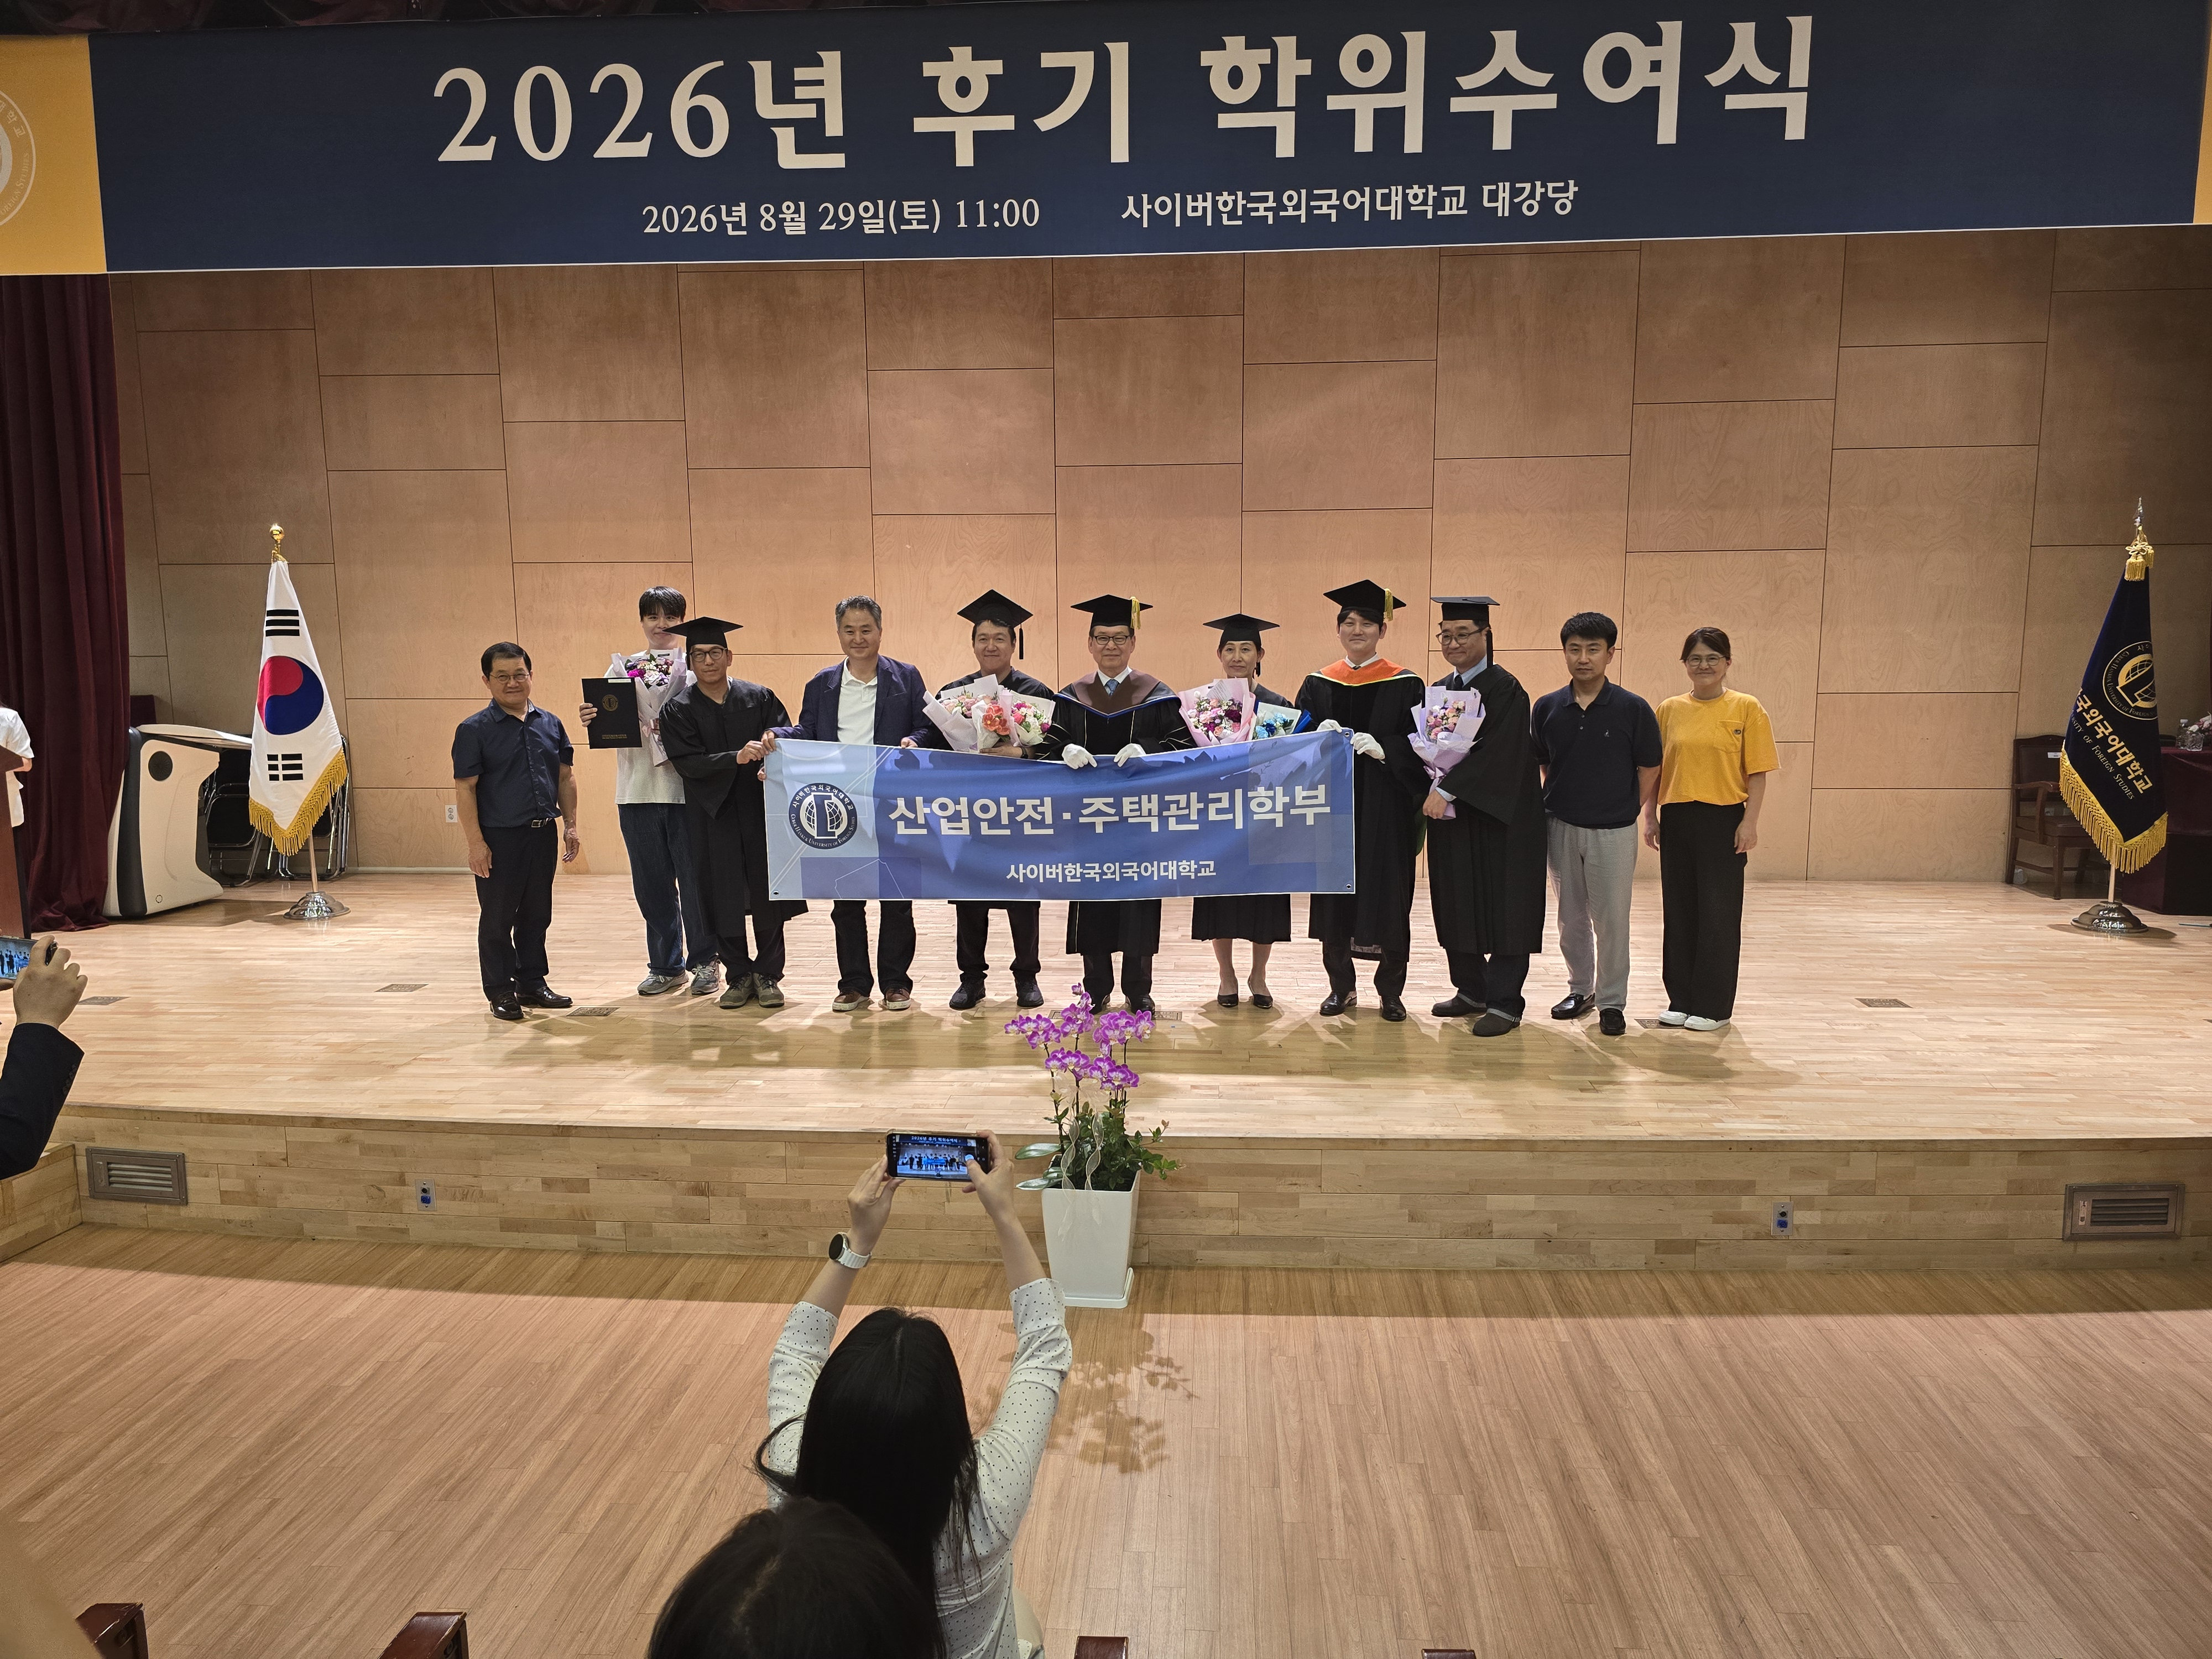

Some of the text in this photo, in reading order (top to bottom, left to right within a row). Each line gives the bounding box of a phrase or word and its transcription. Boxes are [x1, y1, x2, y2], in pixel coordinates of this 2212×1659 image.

[434, 16, 1812, 169] 2026년 후기 학위수여식
[643, 199, 1040, 235] 2026년 8월 29일(토) 11:00
[1121, 180, 1578, 228] 사이버한국외국어대학교 대강당
[2092, 745, 2115, 773] FOREIGN
[2114, 774, 2135, 800] STUDIES
[792, 785, 854, 811] 사이버한국외국어대학교
[889, 784, 1331, 835] 산업안전·주택관리학부
[1006, 860, 1217, 883] 사이버한국외국어대학교
